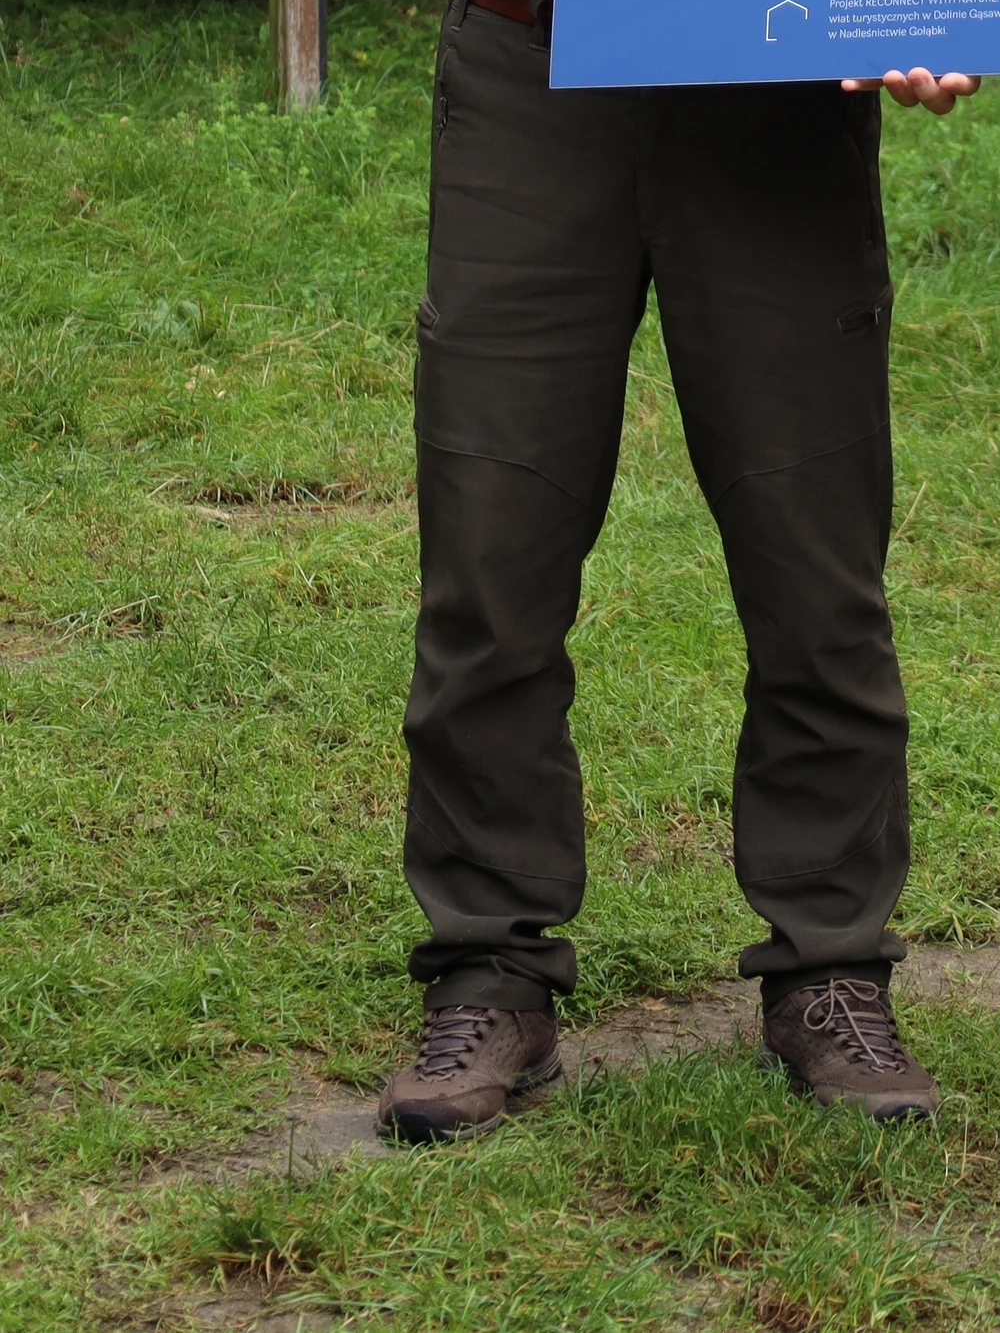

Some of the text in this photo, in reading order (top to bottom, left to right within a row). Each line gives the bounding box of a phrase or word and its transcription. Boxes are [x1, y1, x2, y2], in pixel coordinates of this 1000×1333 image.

[829, 13, 850, 23] wiat
[852, 11, 919, 25] turystycznych
[922, 12, 930, 20] w
[933, 10, 967, 20] Dolinie
[828, 25, 948, 39] w Nadleśnictwie Gołąbki.
